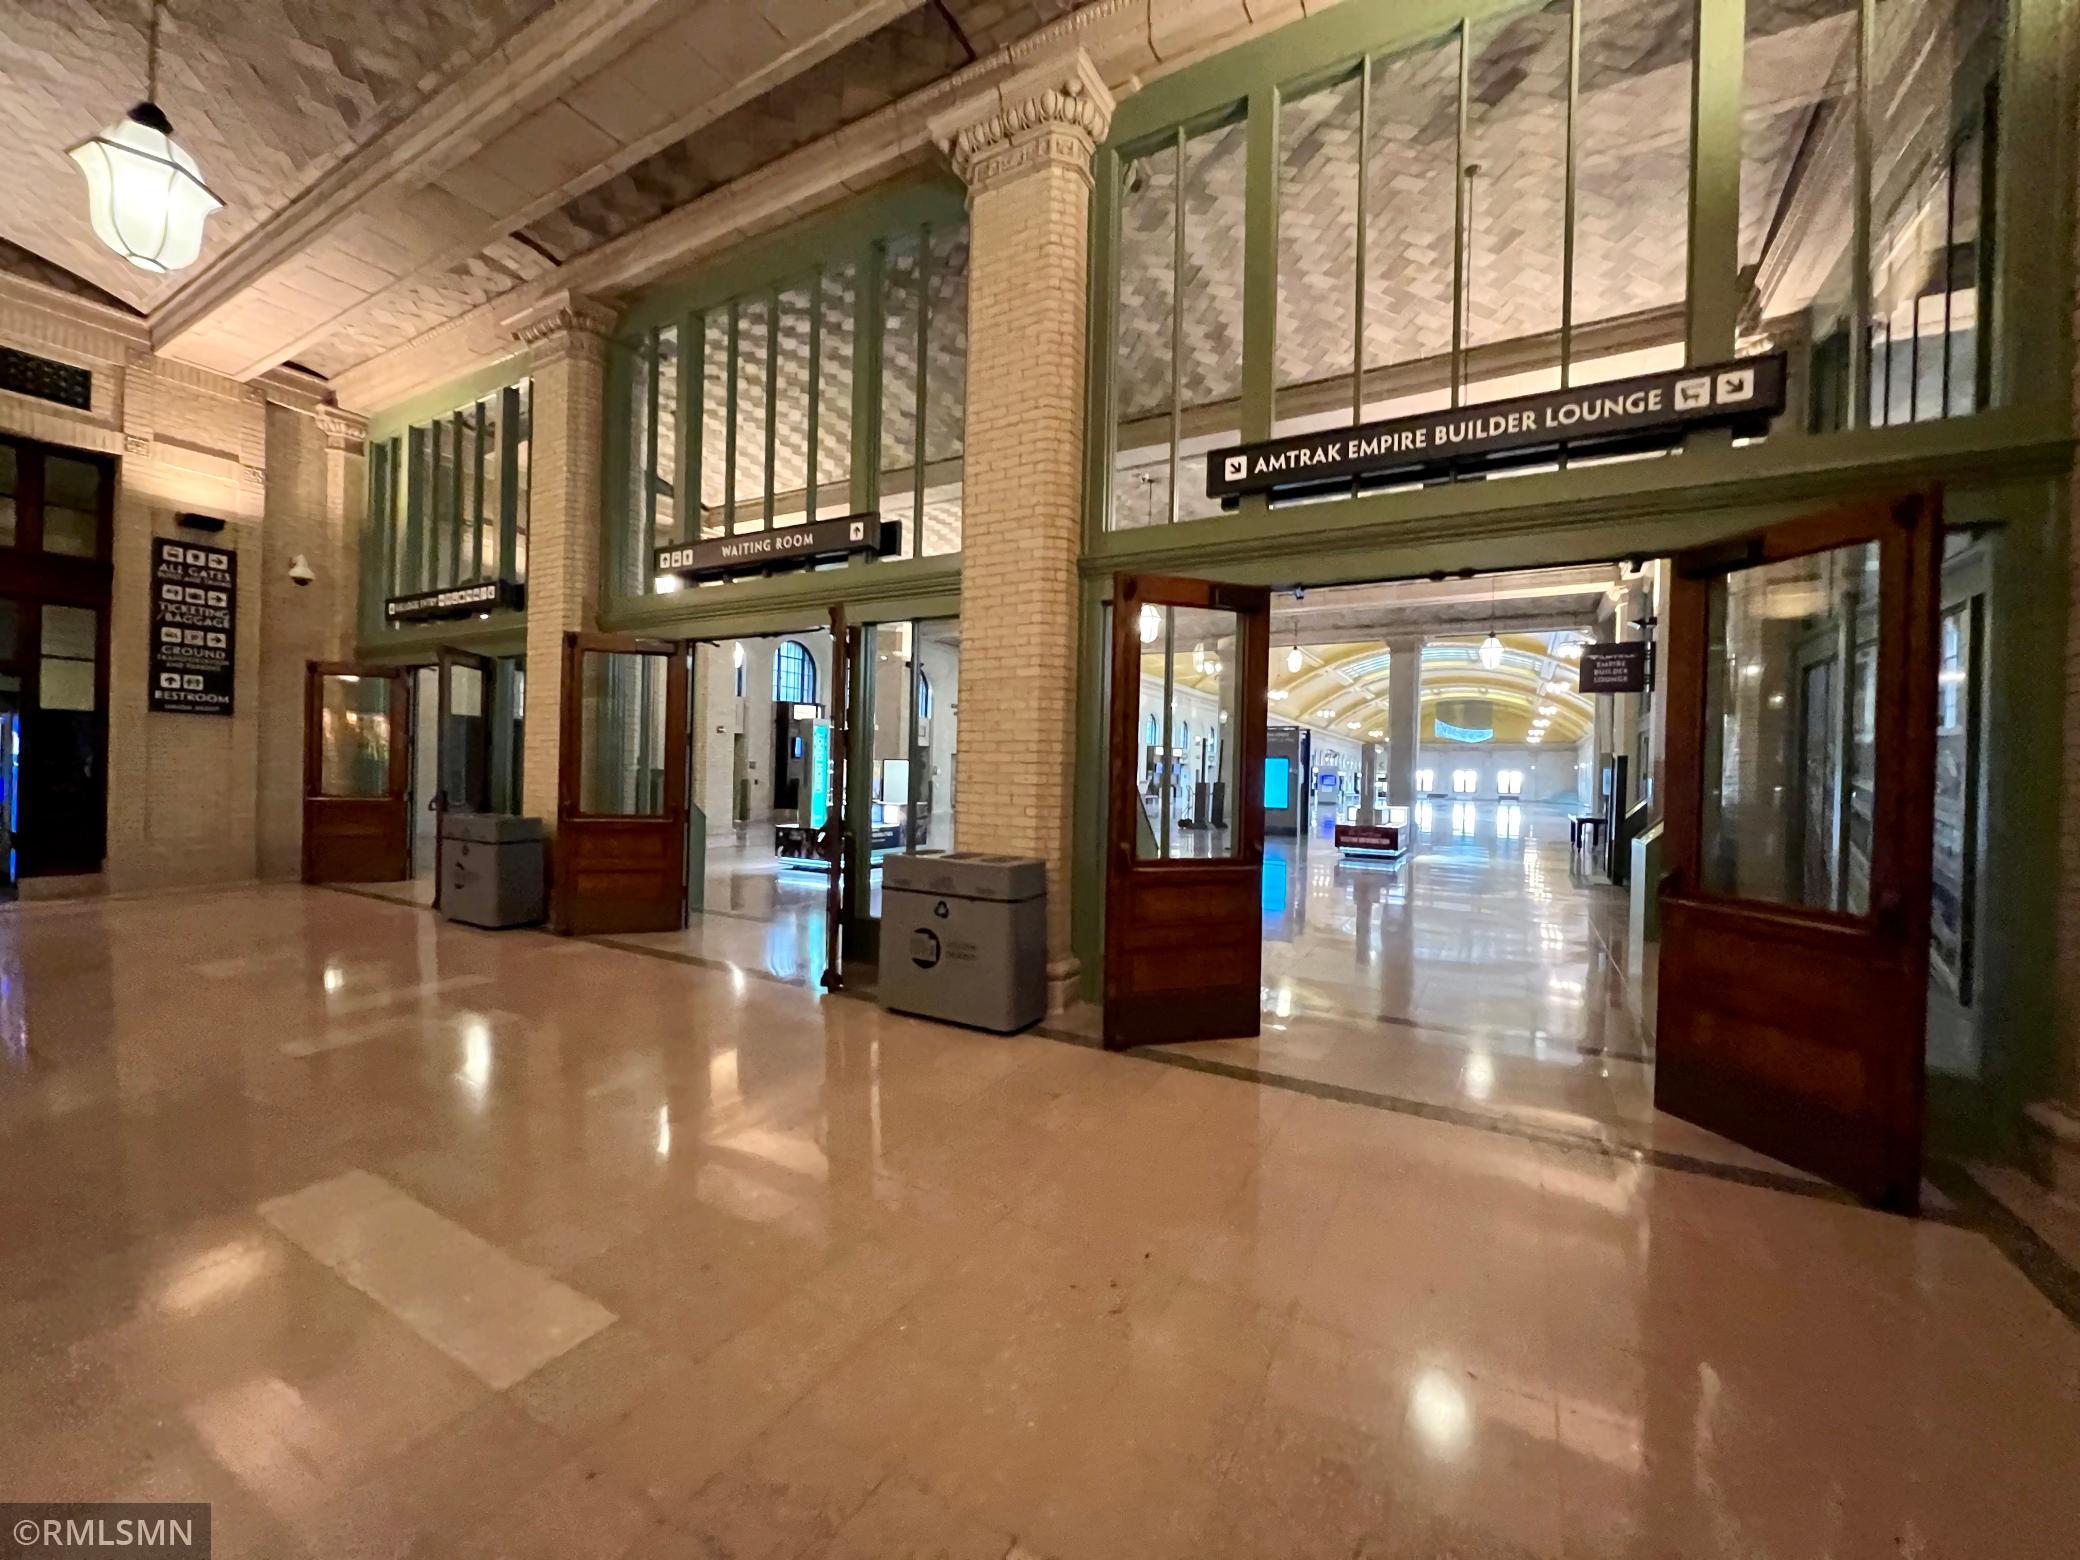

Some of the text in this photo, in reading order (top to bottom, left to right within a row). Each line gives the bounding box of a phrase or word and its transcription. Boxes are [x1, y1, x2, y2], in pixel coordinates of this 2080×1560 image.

[1254, 389, 1663, 475] AMTRAK EMPIRE BUILDER LOUNGE
[721, 533, 814, 558] WAITING ROOM
[158, 563, 183, 575] ALL
[188, 567, 231, 581] GATES
[158, 601, 229, 618] TICKETING
[161, 644, 226, 659] GROUND
[1593, 668, 1628, 676] BUILDER
[154, 690, 230, 704] RESTROOM
